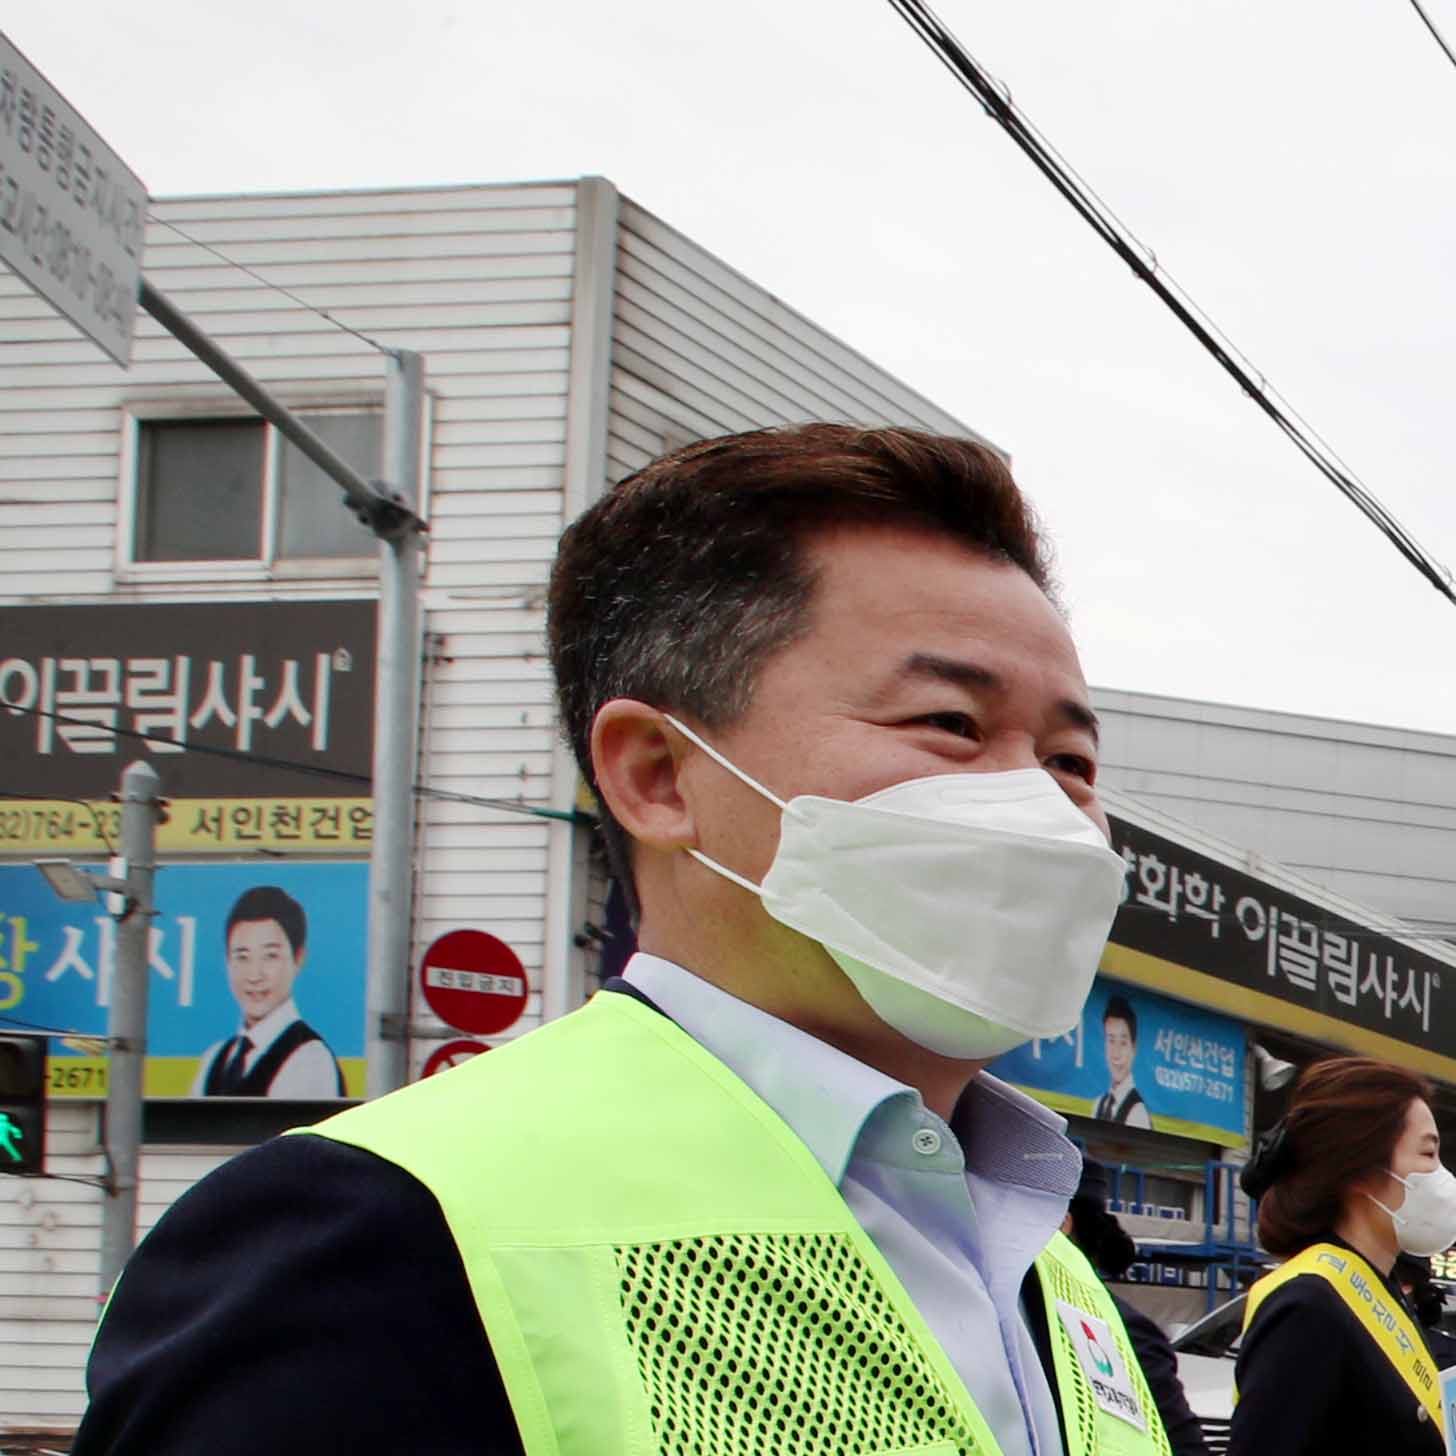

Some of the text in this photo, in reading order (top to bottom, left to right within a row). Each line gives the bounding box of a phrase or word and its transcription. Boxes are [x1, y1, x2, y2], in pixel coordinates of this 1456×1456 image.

[2, 652, 333, 755] 이끌림샤시
[1235, 896, 1431, 1033] 이끌림샤시
[1155, 1028, 1236, 1079] 서인천건업
